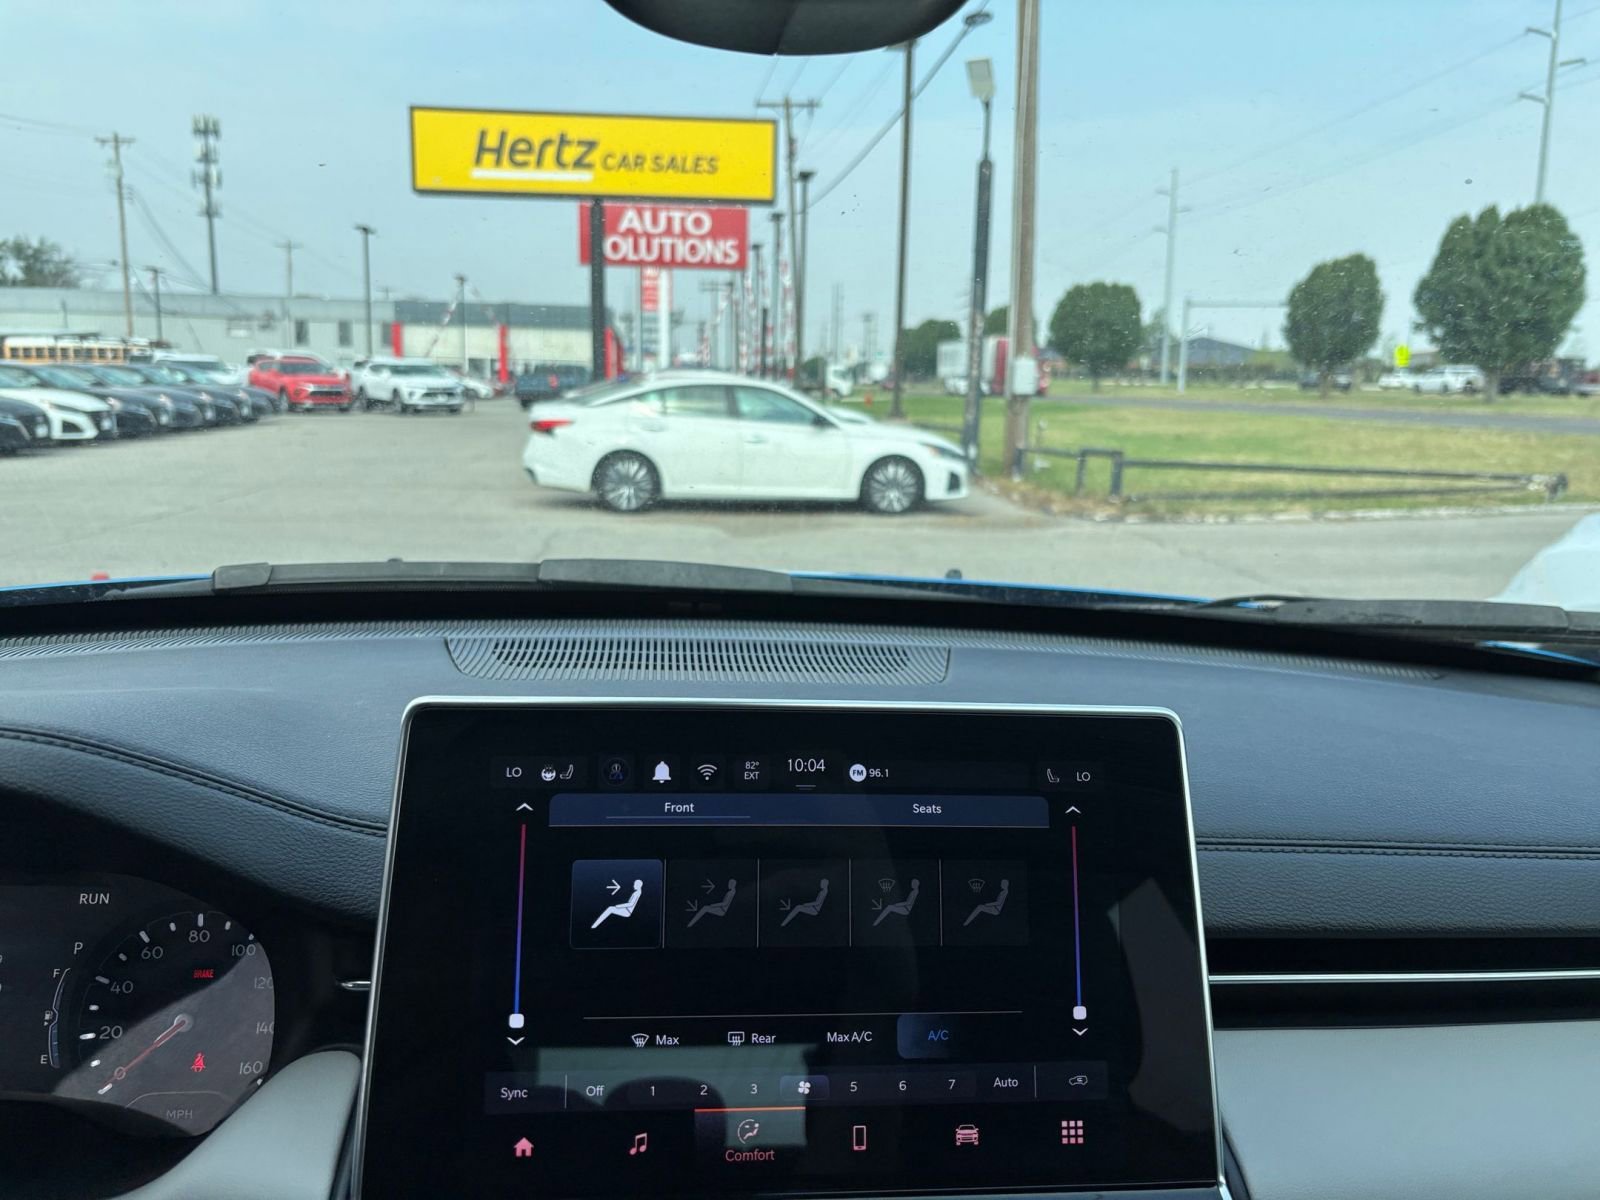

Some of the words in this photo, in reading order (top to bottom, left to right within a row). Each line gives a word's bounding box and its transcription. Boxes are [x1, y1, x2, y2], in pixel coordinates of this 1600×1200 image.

[474, 129, 599, 170] Hertz
[600, 151, 645, 174] CAR
[652, 153, 720, 176] SALES
[617, 208, 712, 236] AUTO
[603, 236, 740, 265] OLUTIONS
[788, 758, 826, 772] 10:04
[506, 766, 522, 778] LO
[744, 772, 760, 780] EXT
[851, 768, 866, 778] FM
[868, 768, 889, 778] 96.1
[1076, 771, 1091, 782] LO
[664, 802, 695, 813] Front
[912, 803, 942, 814] Seats
[79, 893, 110, 905] RUN
[188, 929, 211, 943] 80
[73, 941, 84, 955] P
[140, 945, 164, 960] 60
[231, 944, 257, 957] 100
[53, 968, 60, 978] F
[108, 980, 134, 994] 40
[99, 1026, 122, 1040] 20
[751, 1032, 777, 1044] Rear
[827, 1031, 850, 1043] Max
[850, 1030, 873, 1043] A/C
[927, 1029, 949, 1041] A/C
[655, 1034, 680, 1046] Max
[39, 1054, 48, 1065] E
[114, 1067, 126, 1080] 0
[239, 1060, 263, 1075] 160
[850, 1081, 858, 1092] 5
[898, 1080, 907, 1091] 6
[948, 1079, 956, 1090] 7
[993, 1076, 1019, 1088] Auto
[500, 1087, 528, 1101] Sync
[585, 1084, 605, 1097] Off
[650, 1085, 655, 1097] 1
[700, 1084, 708, 1096] 2
[749, 1083, 759, 1096] 3
[166, 1109, 193, 1120] MPH
[725, 1148, 775, 1162] Comfort
